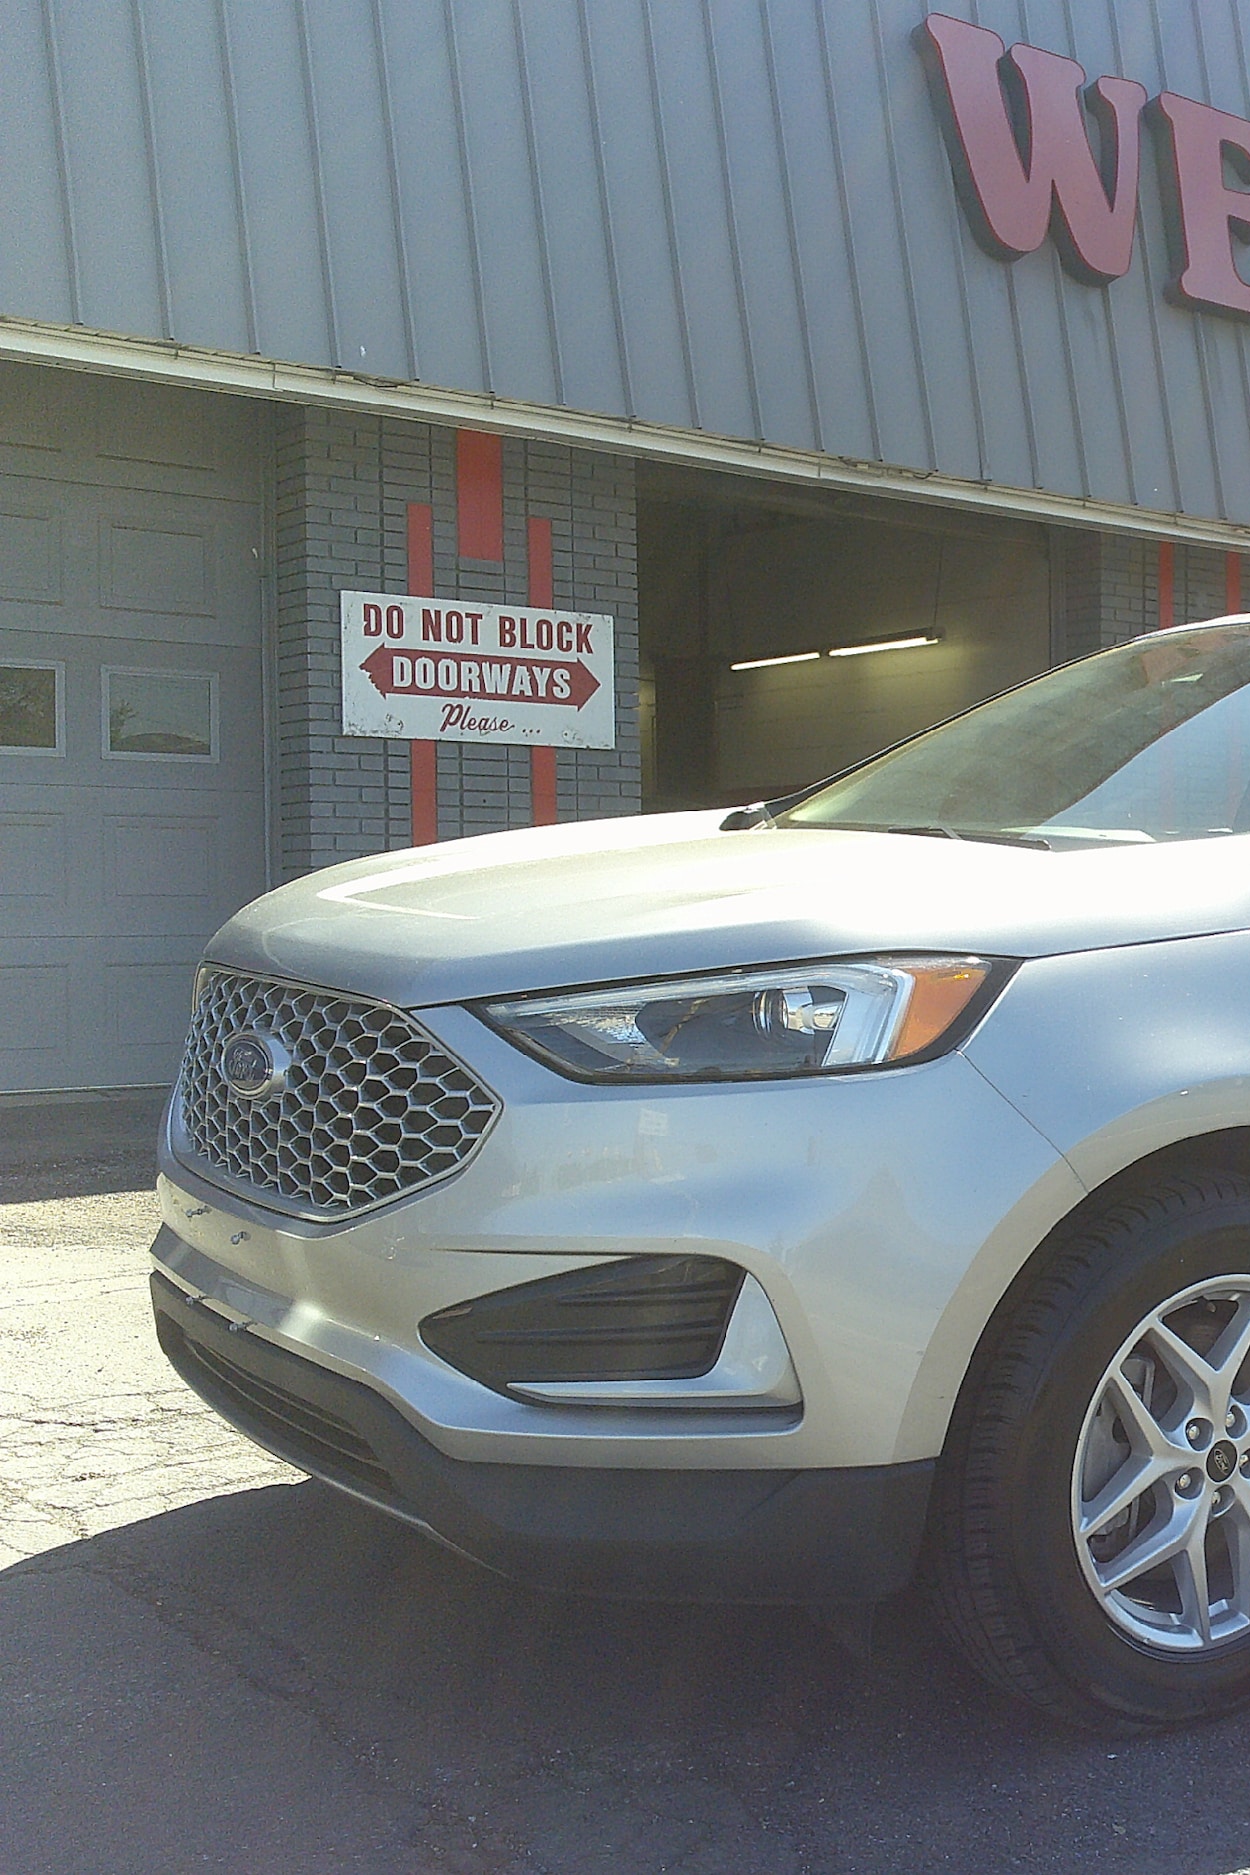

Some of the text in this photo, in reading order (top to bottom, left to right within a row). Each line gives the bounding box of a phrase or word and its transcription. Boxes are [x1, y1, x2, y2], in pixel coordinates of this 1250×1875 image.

[363, 603, 593, 654] DO NOT BLOCK
[392, 656, 571, 699] DOORWAYS
[439, 703, 515, 733] Please
